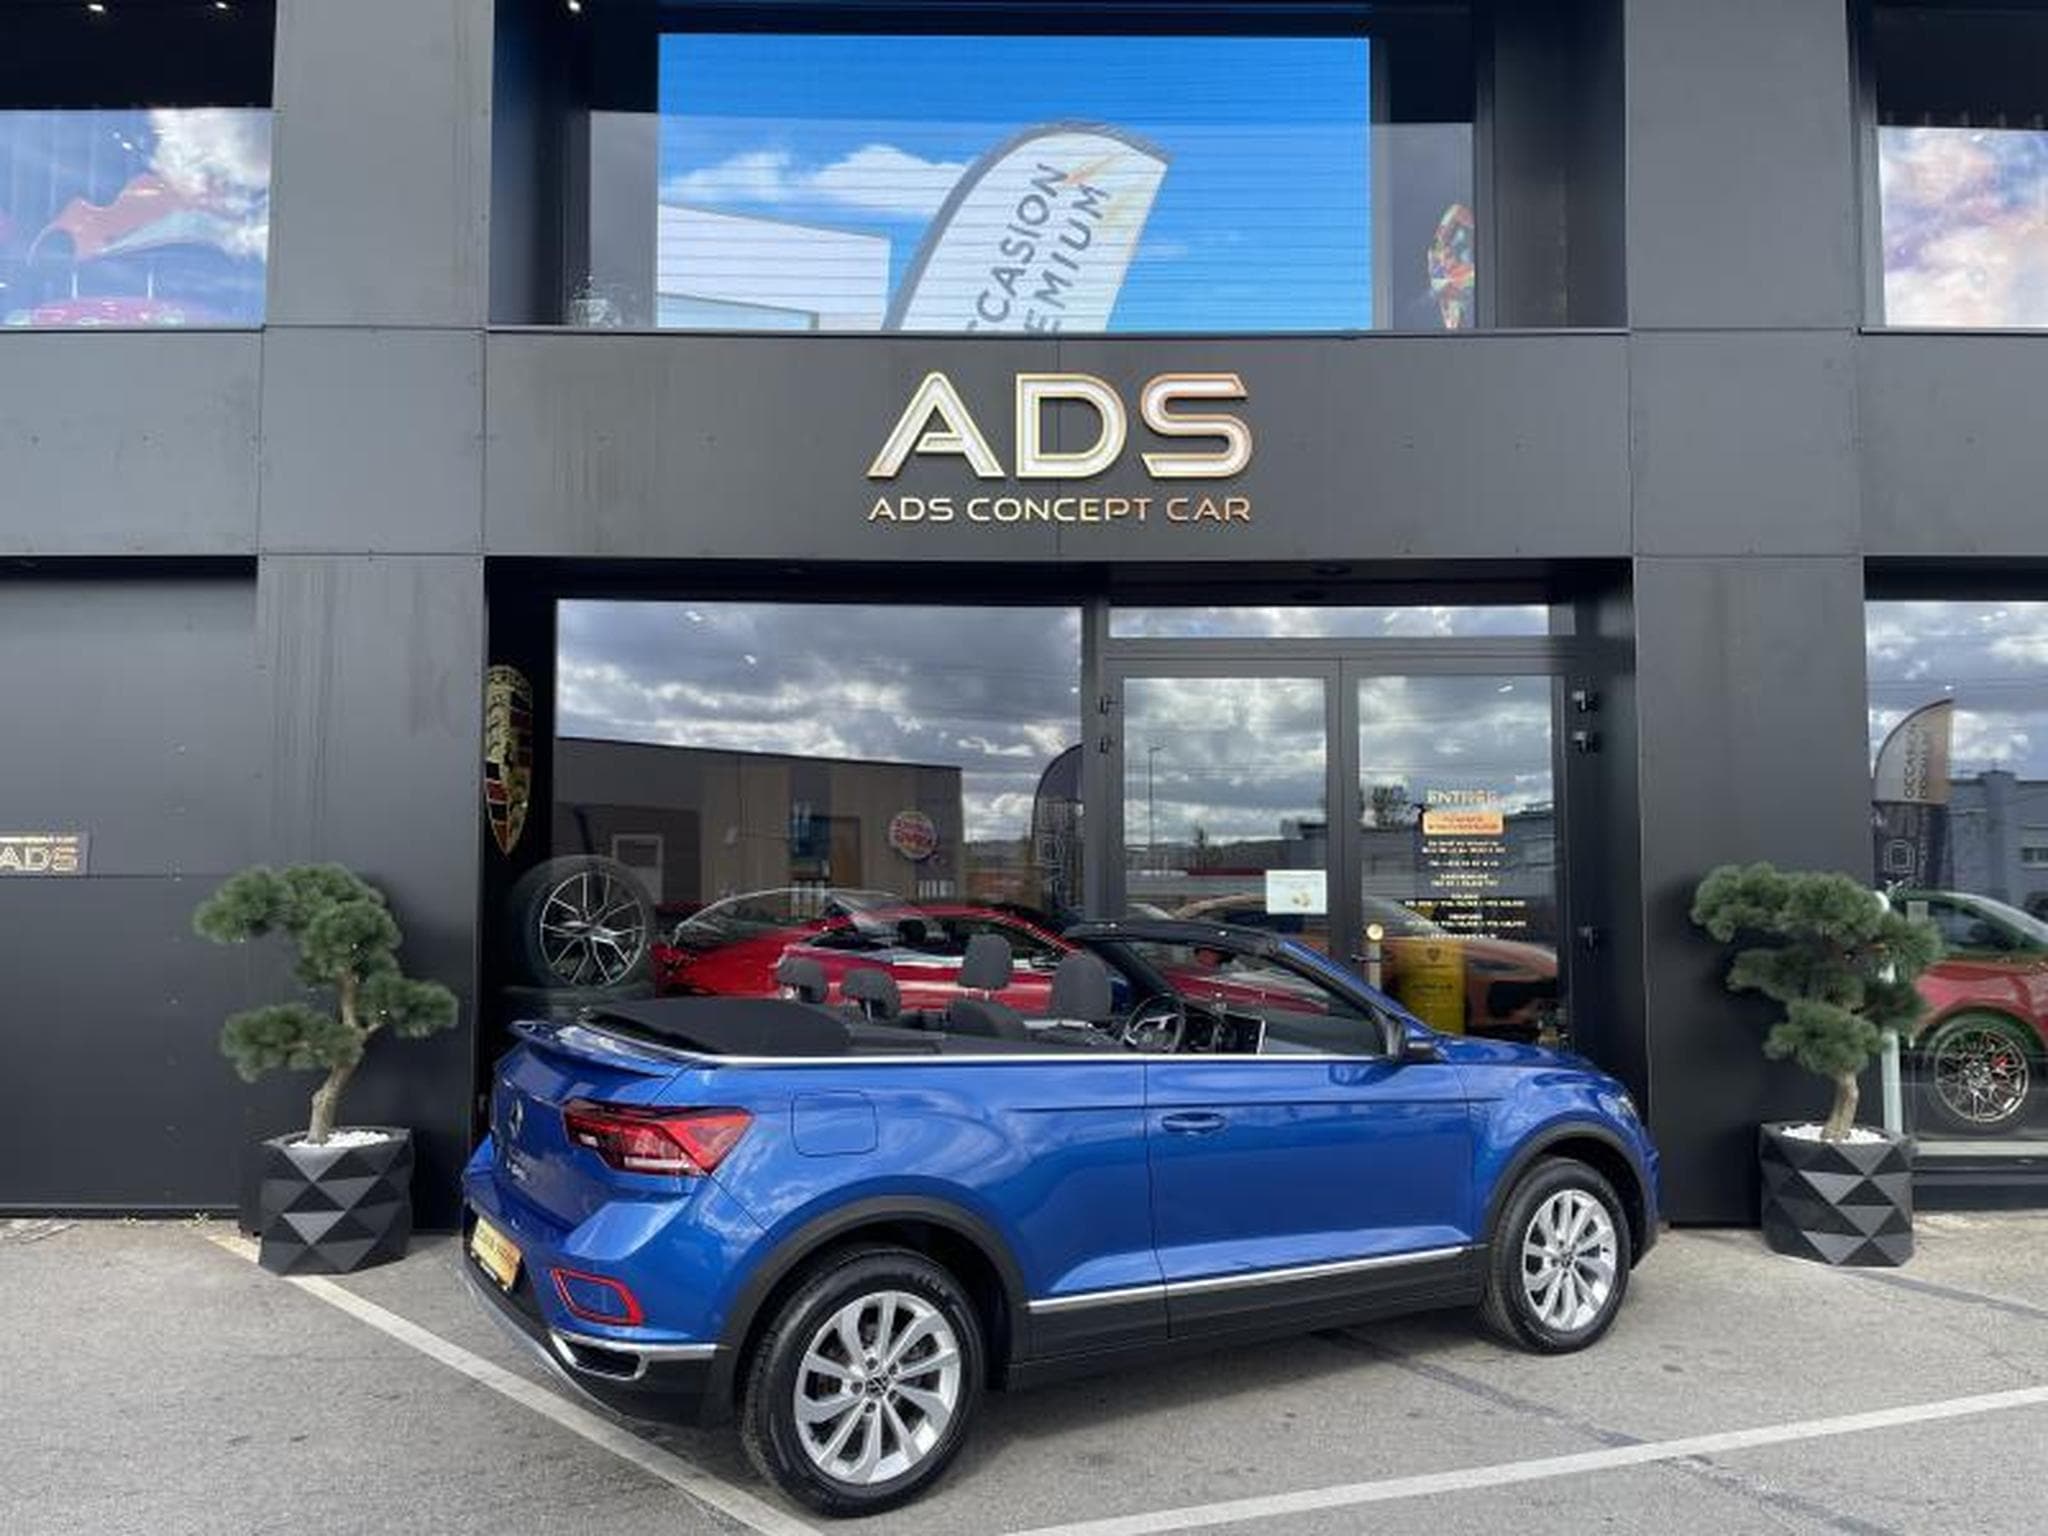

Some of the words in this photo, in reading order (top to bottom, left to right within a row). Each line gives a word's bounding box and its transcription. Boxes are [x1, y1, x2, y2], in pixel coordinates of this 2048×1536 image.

[964, 162, 1069, 333] CASION
[866, 371, 1253, 479] ADS
[868, 497, 955, 522] ADS
[967, 497, 1152, 522] CONCEPT
[1166, 497, 1252, 522] CAR
[0, 846, 80, 872] ADS
